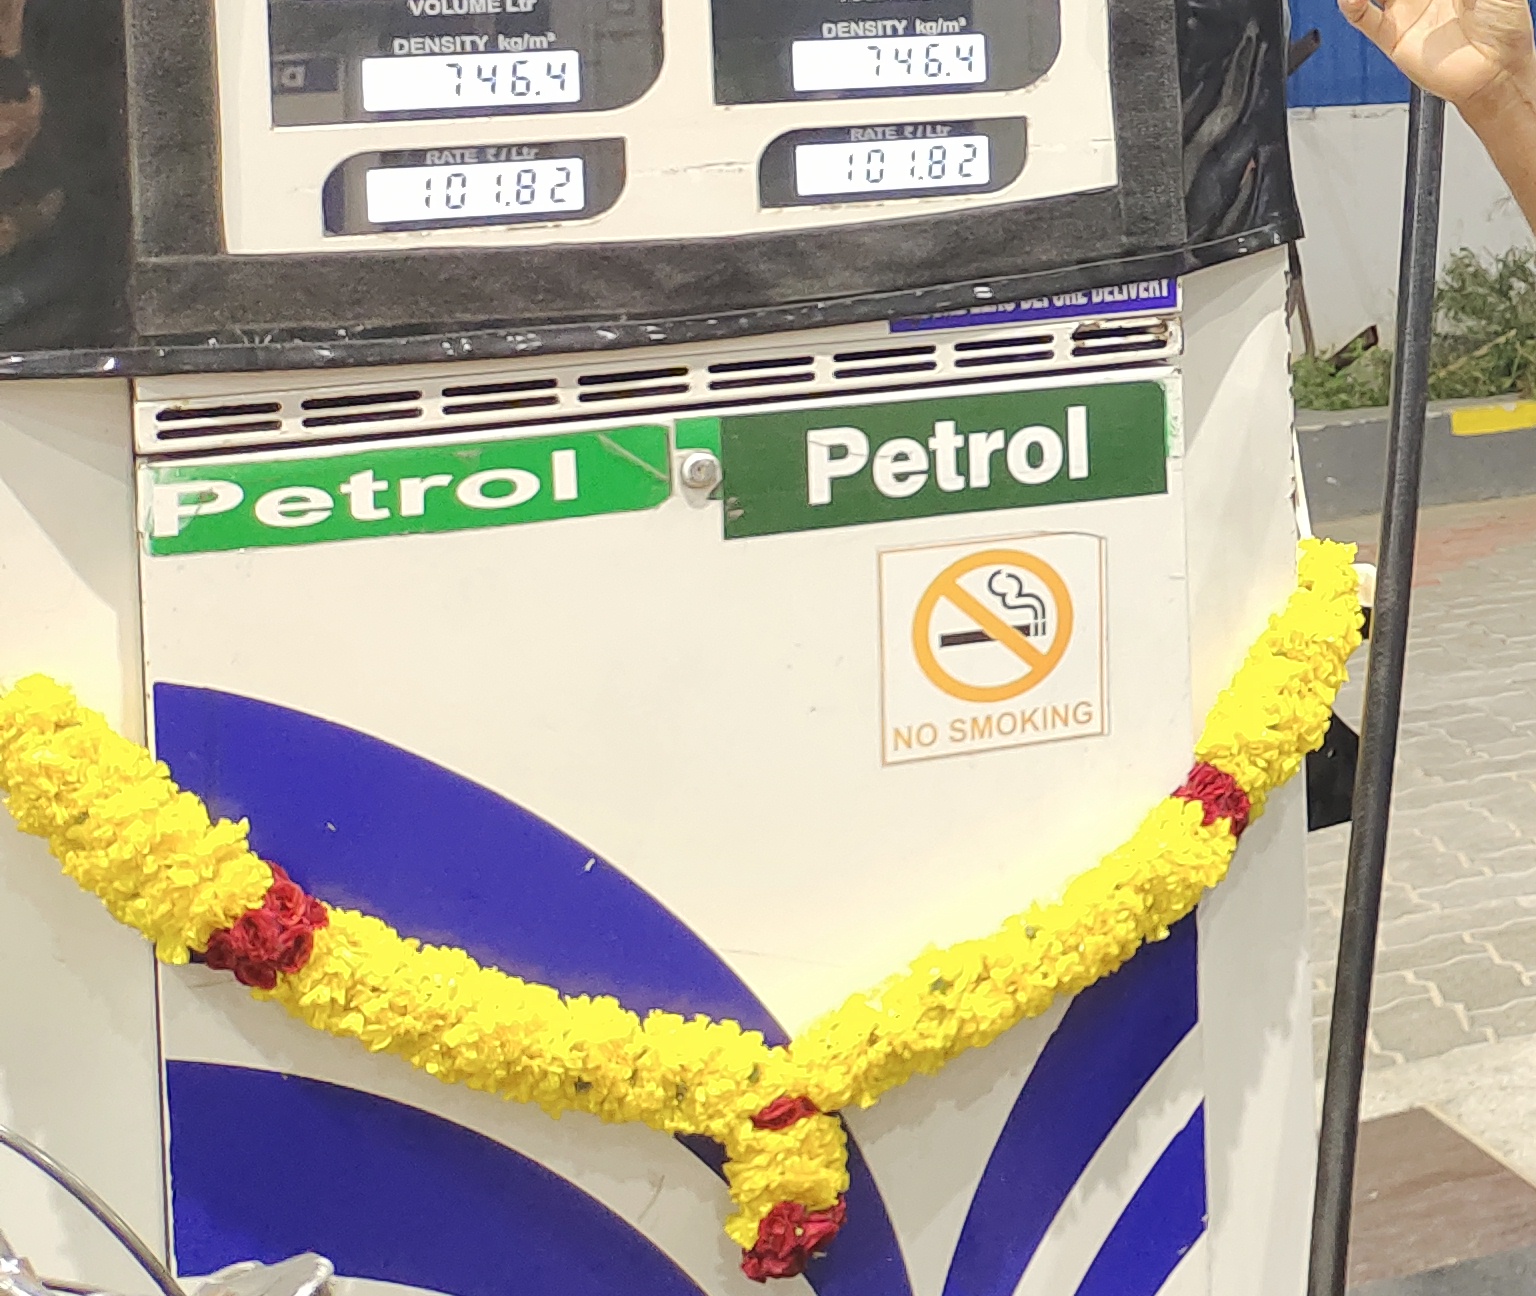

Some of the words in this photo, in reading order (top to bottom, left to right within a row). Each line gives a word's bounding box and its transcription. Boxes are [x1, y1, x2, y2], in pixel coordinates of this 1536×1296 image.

[393, 34, 489, 54] DENSITY
[822, 19, 907, 38] DENSITY
[446, 60, 567, 96] 746.4
[867, 43, 973, 78] 746.4
[850, 126, 898, 142] RATE
[425, 148, 479, 165] RATE
[848, 143, 977, 184] 101.82
[425, 166, 571, 209] 101.82
[806, 405, 1090, 506] Petrol
[151, 448, 578, 538] Petrol
[892, 722, 938, 751] NO
[949, 701, 1094, 743] SMOKING
